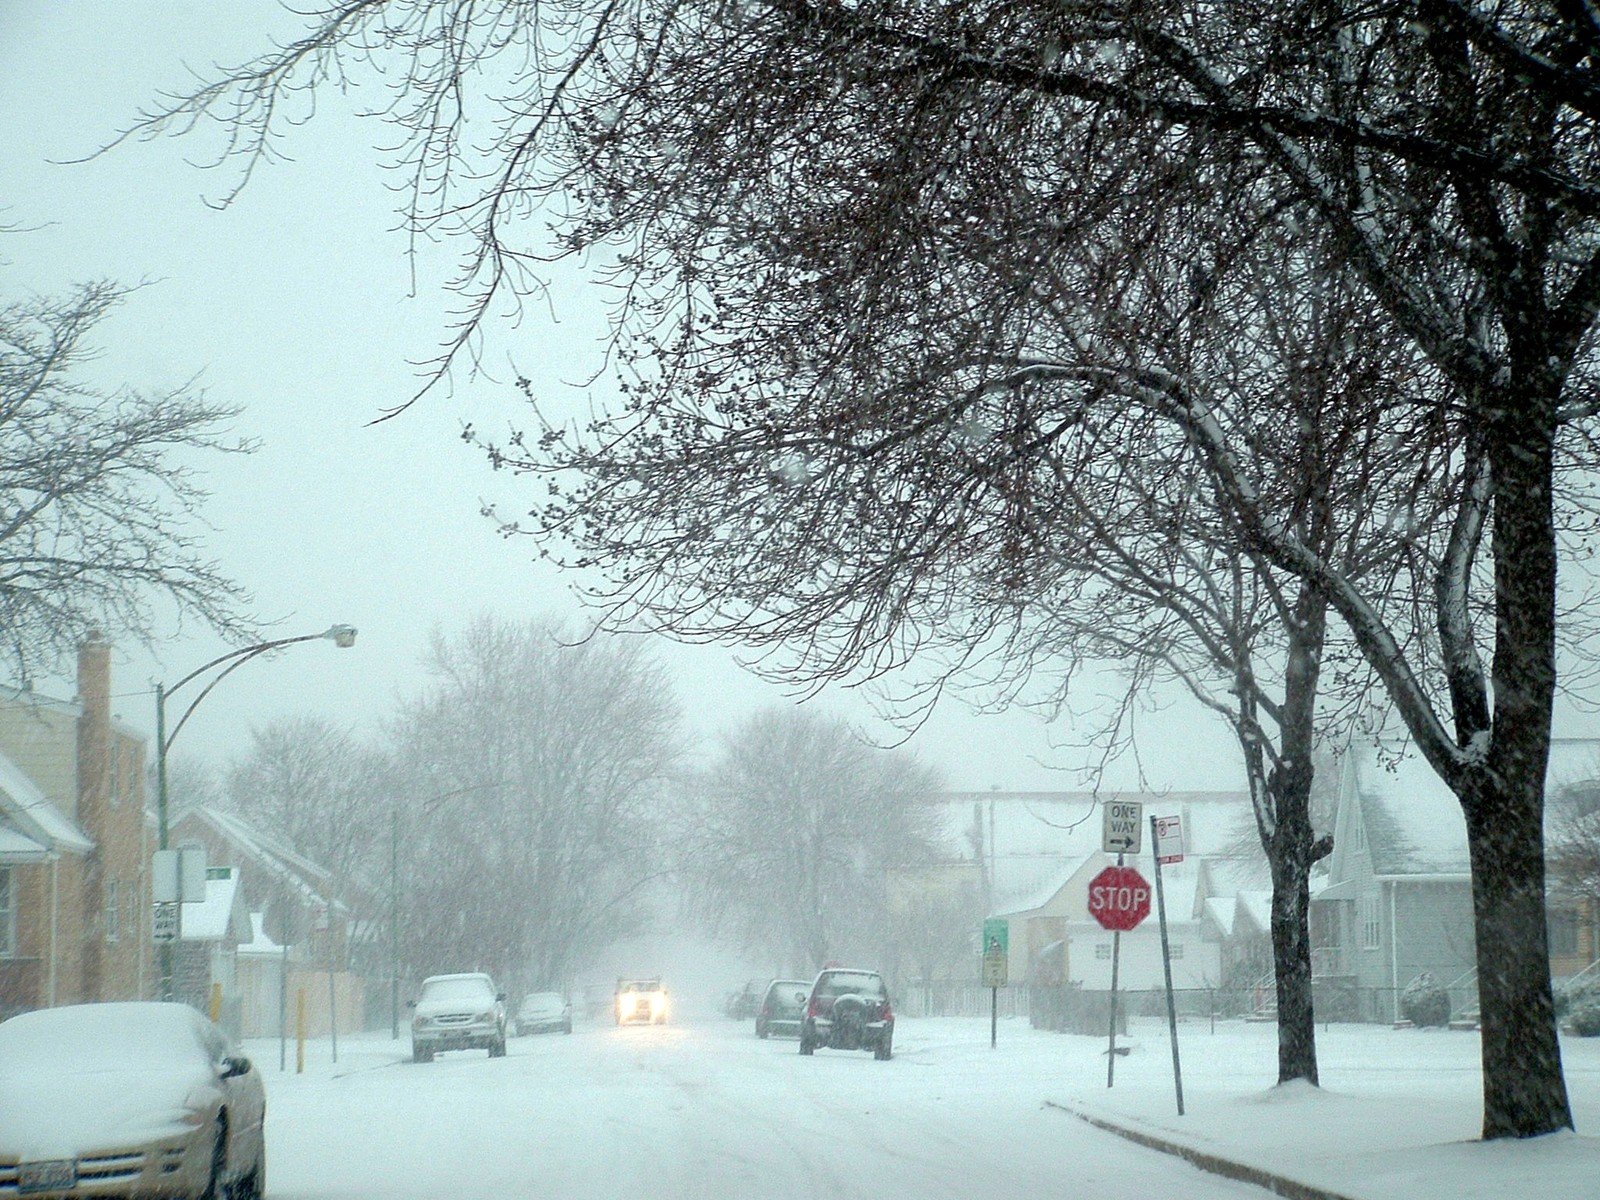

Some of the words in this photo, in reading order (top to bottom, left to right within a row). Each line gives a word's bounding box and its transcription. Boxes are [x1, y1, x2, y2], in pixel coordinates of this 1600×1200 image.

[1112, 805, 1137, 819] ONE
[1112, 821, 1136, 833] WAY
[1092, 886, 1147, 911] STOP
